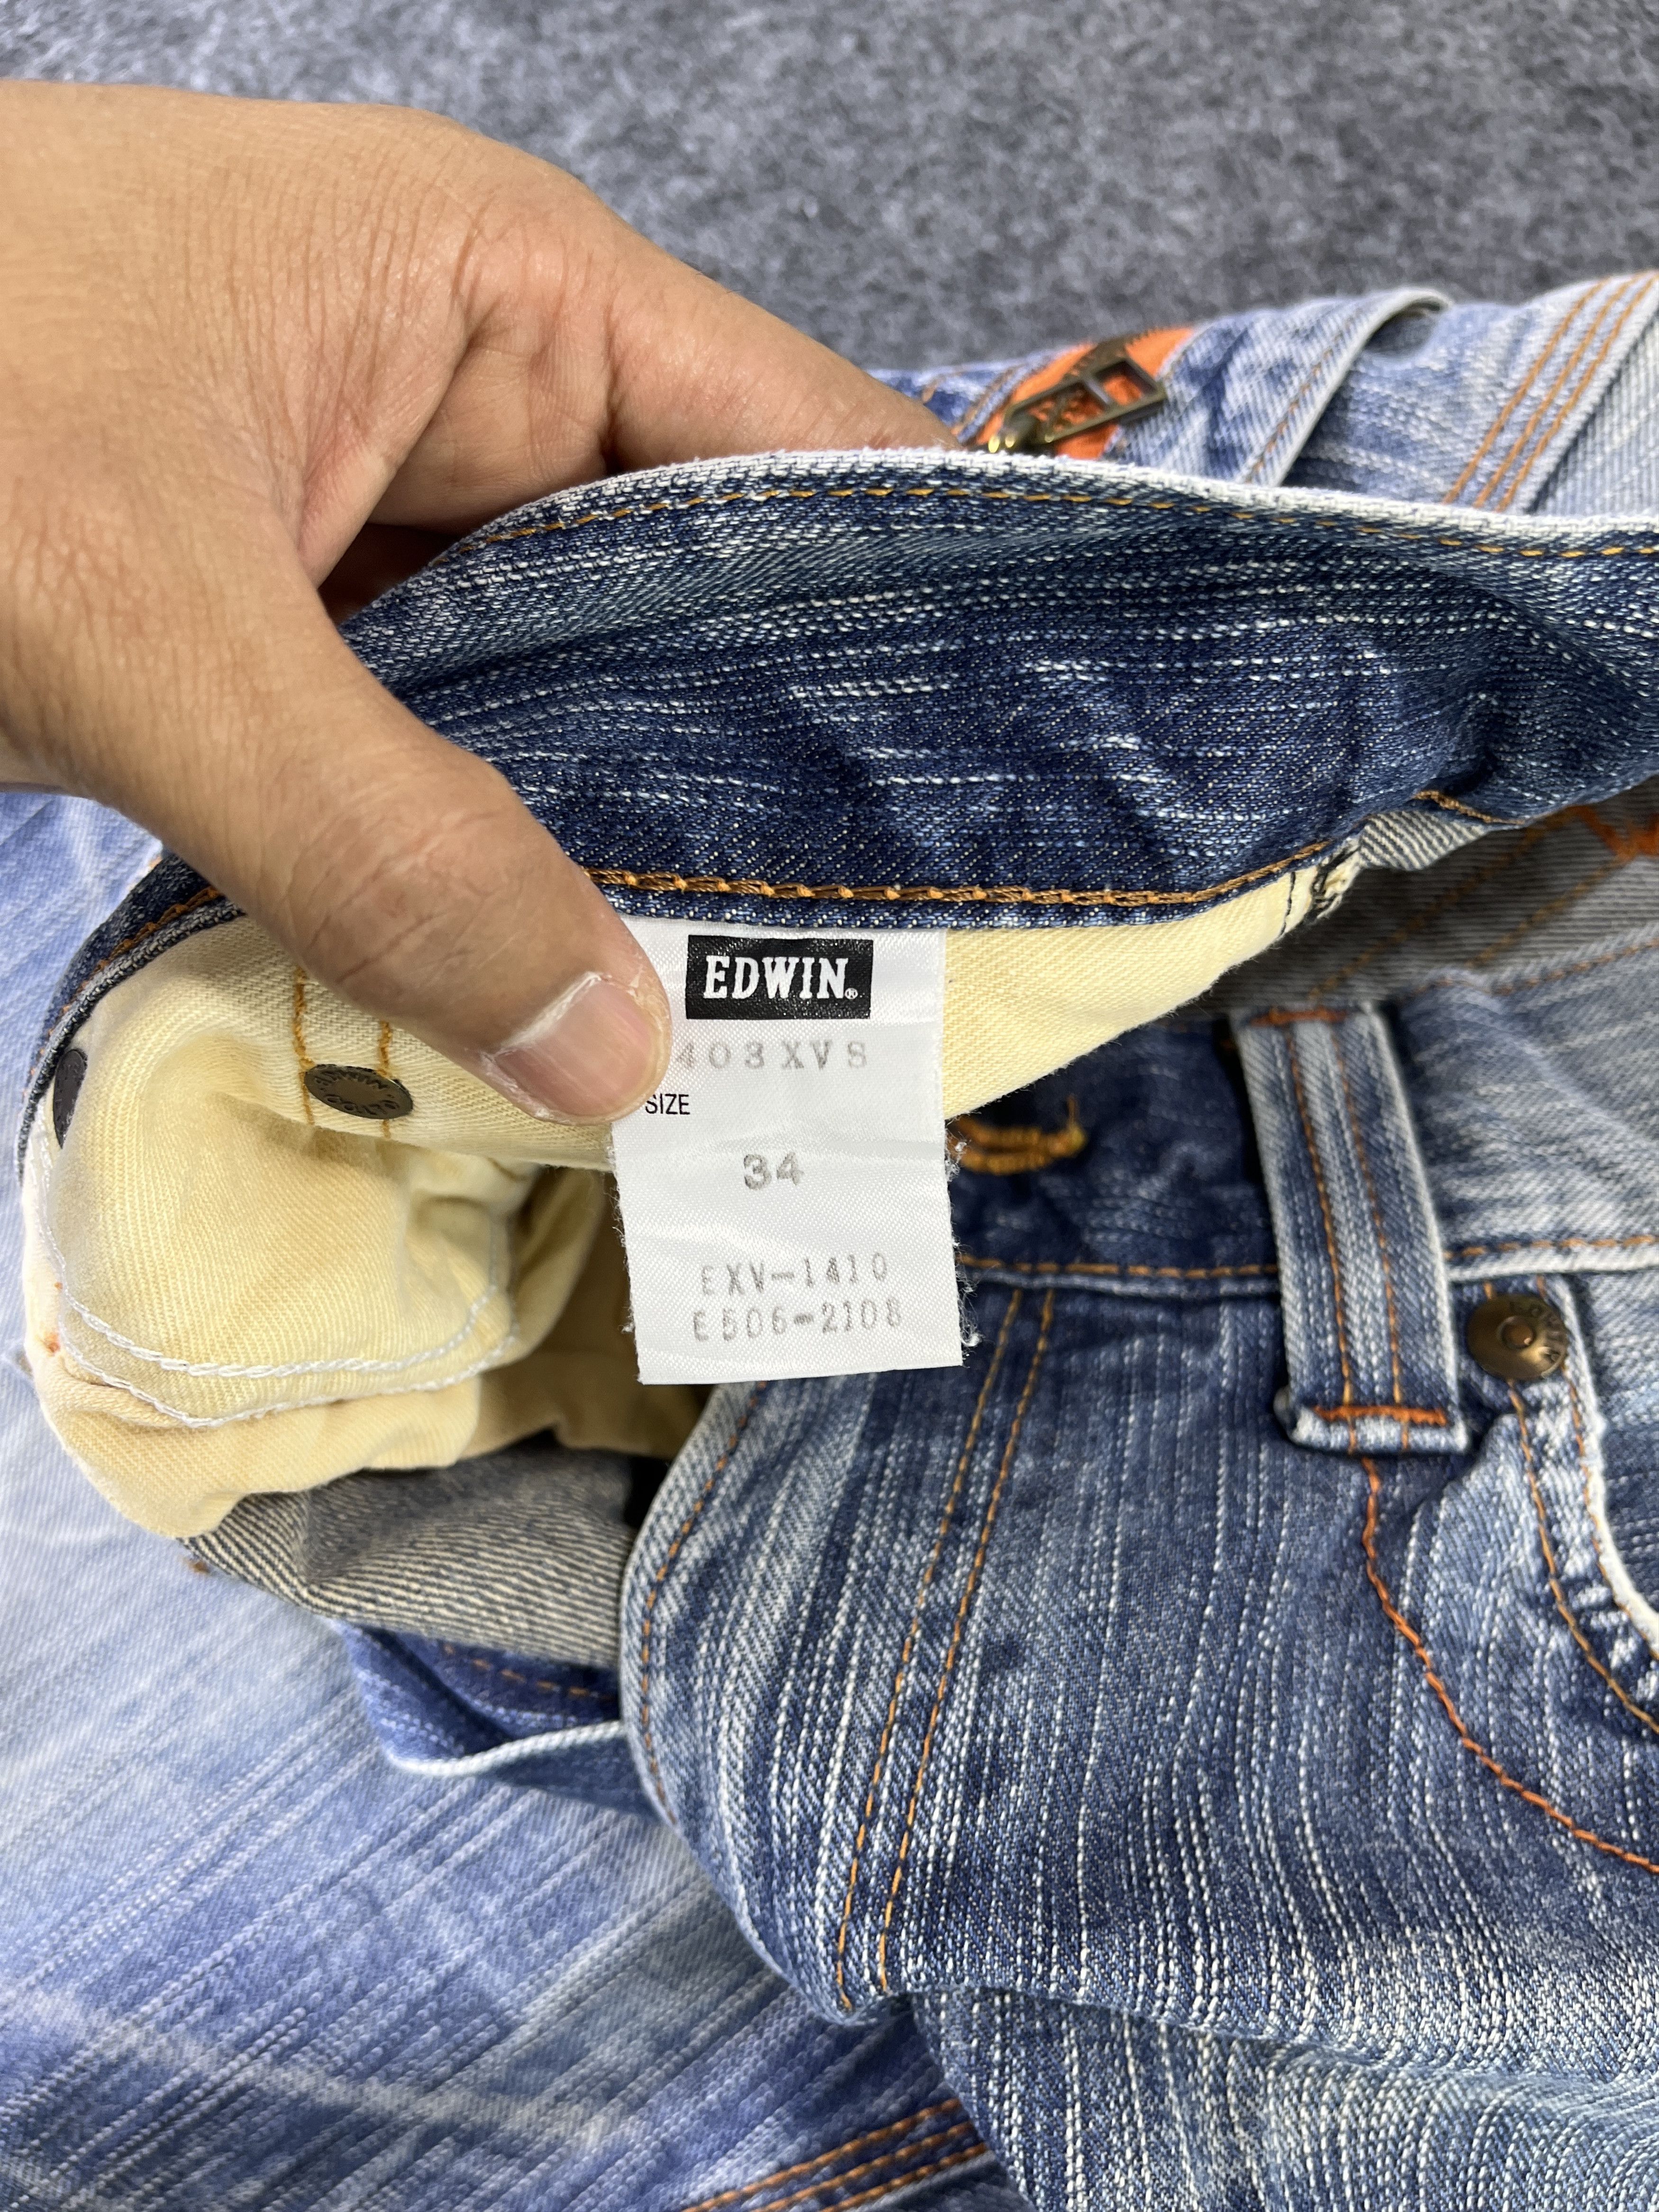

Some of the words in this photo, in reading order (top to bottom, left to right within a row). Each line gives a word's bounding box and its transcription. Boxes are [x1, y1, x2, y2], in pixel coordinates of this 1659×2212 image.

[703, 955, 848, 999] EDWIN
[645, 1092, 690, 1115] SIZE
[743, 1151, 804, 1191] 34
[701, 1252, 887, 1296] EXV-1410
[693, 1297, 902, 1341] E506-2108
